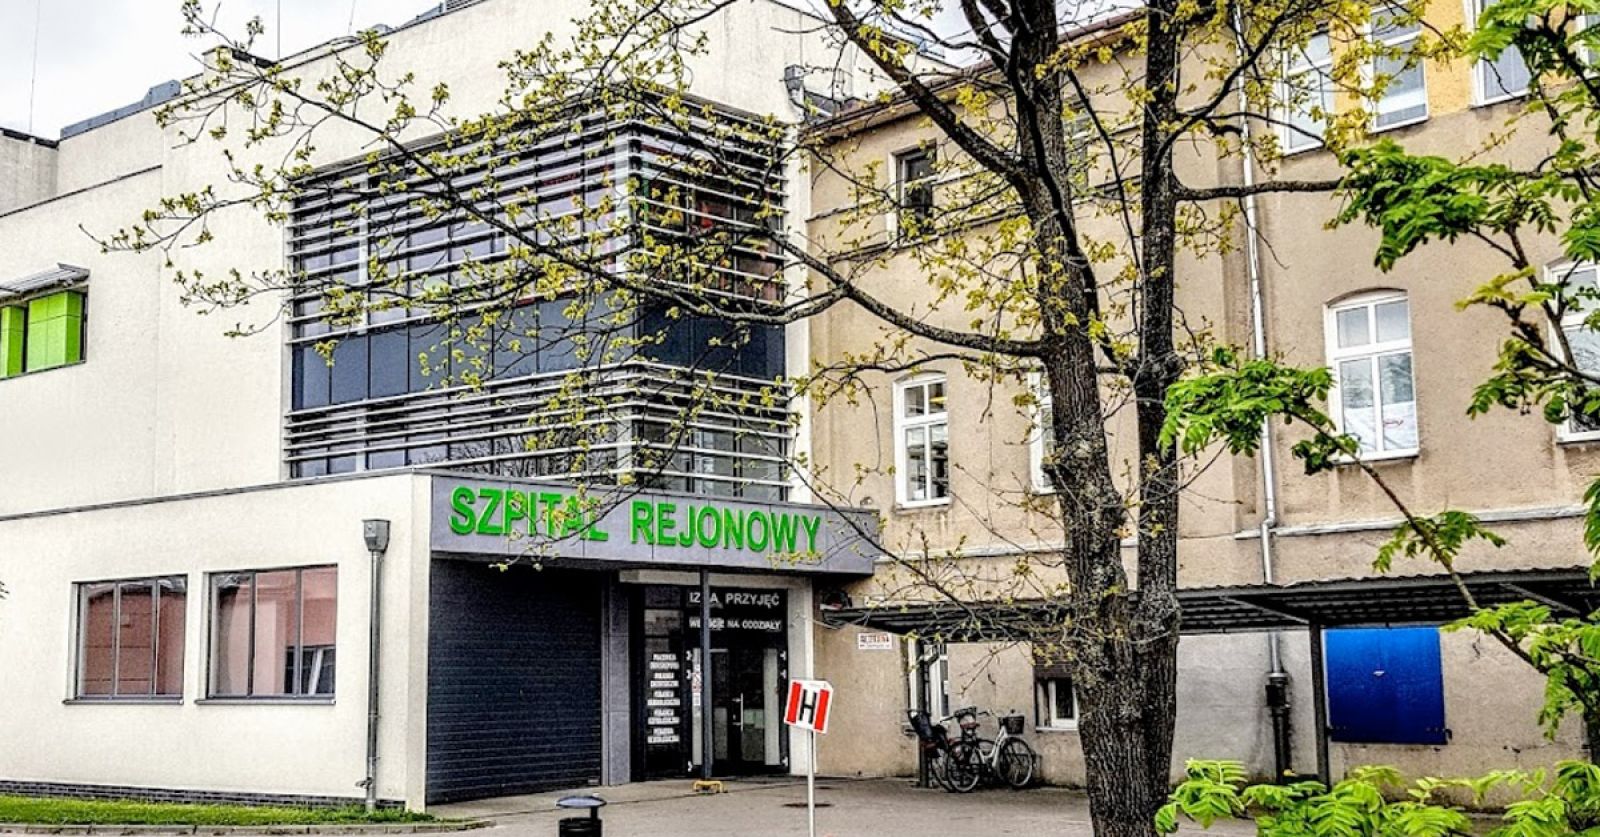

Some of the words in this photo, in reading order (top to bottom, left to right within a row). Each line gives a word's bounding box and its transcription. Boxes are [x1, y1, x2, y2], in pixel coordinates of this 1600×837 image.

[449, 485, 609, 541] SZPITAL
[629, 500, 822, 554] REJONOWY
[688, 592, 719, 604] IZA
[725, 592, 780, 608] PRZYJĘĆ
[799, 688, 817, 725] H
